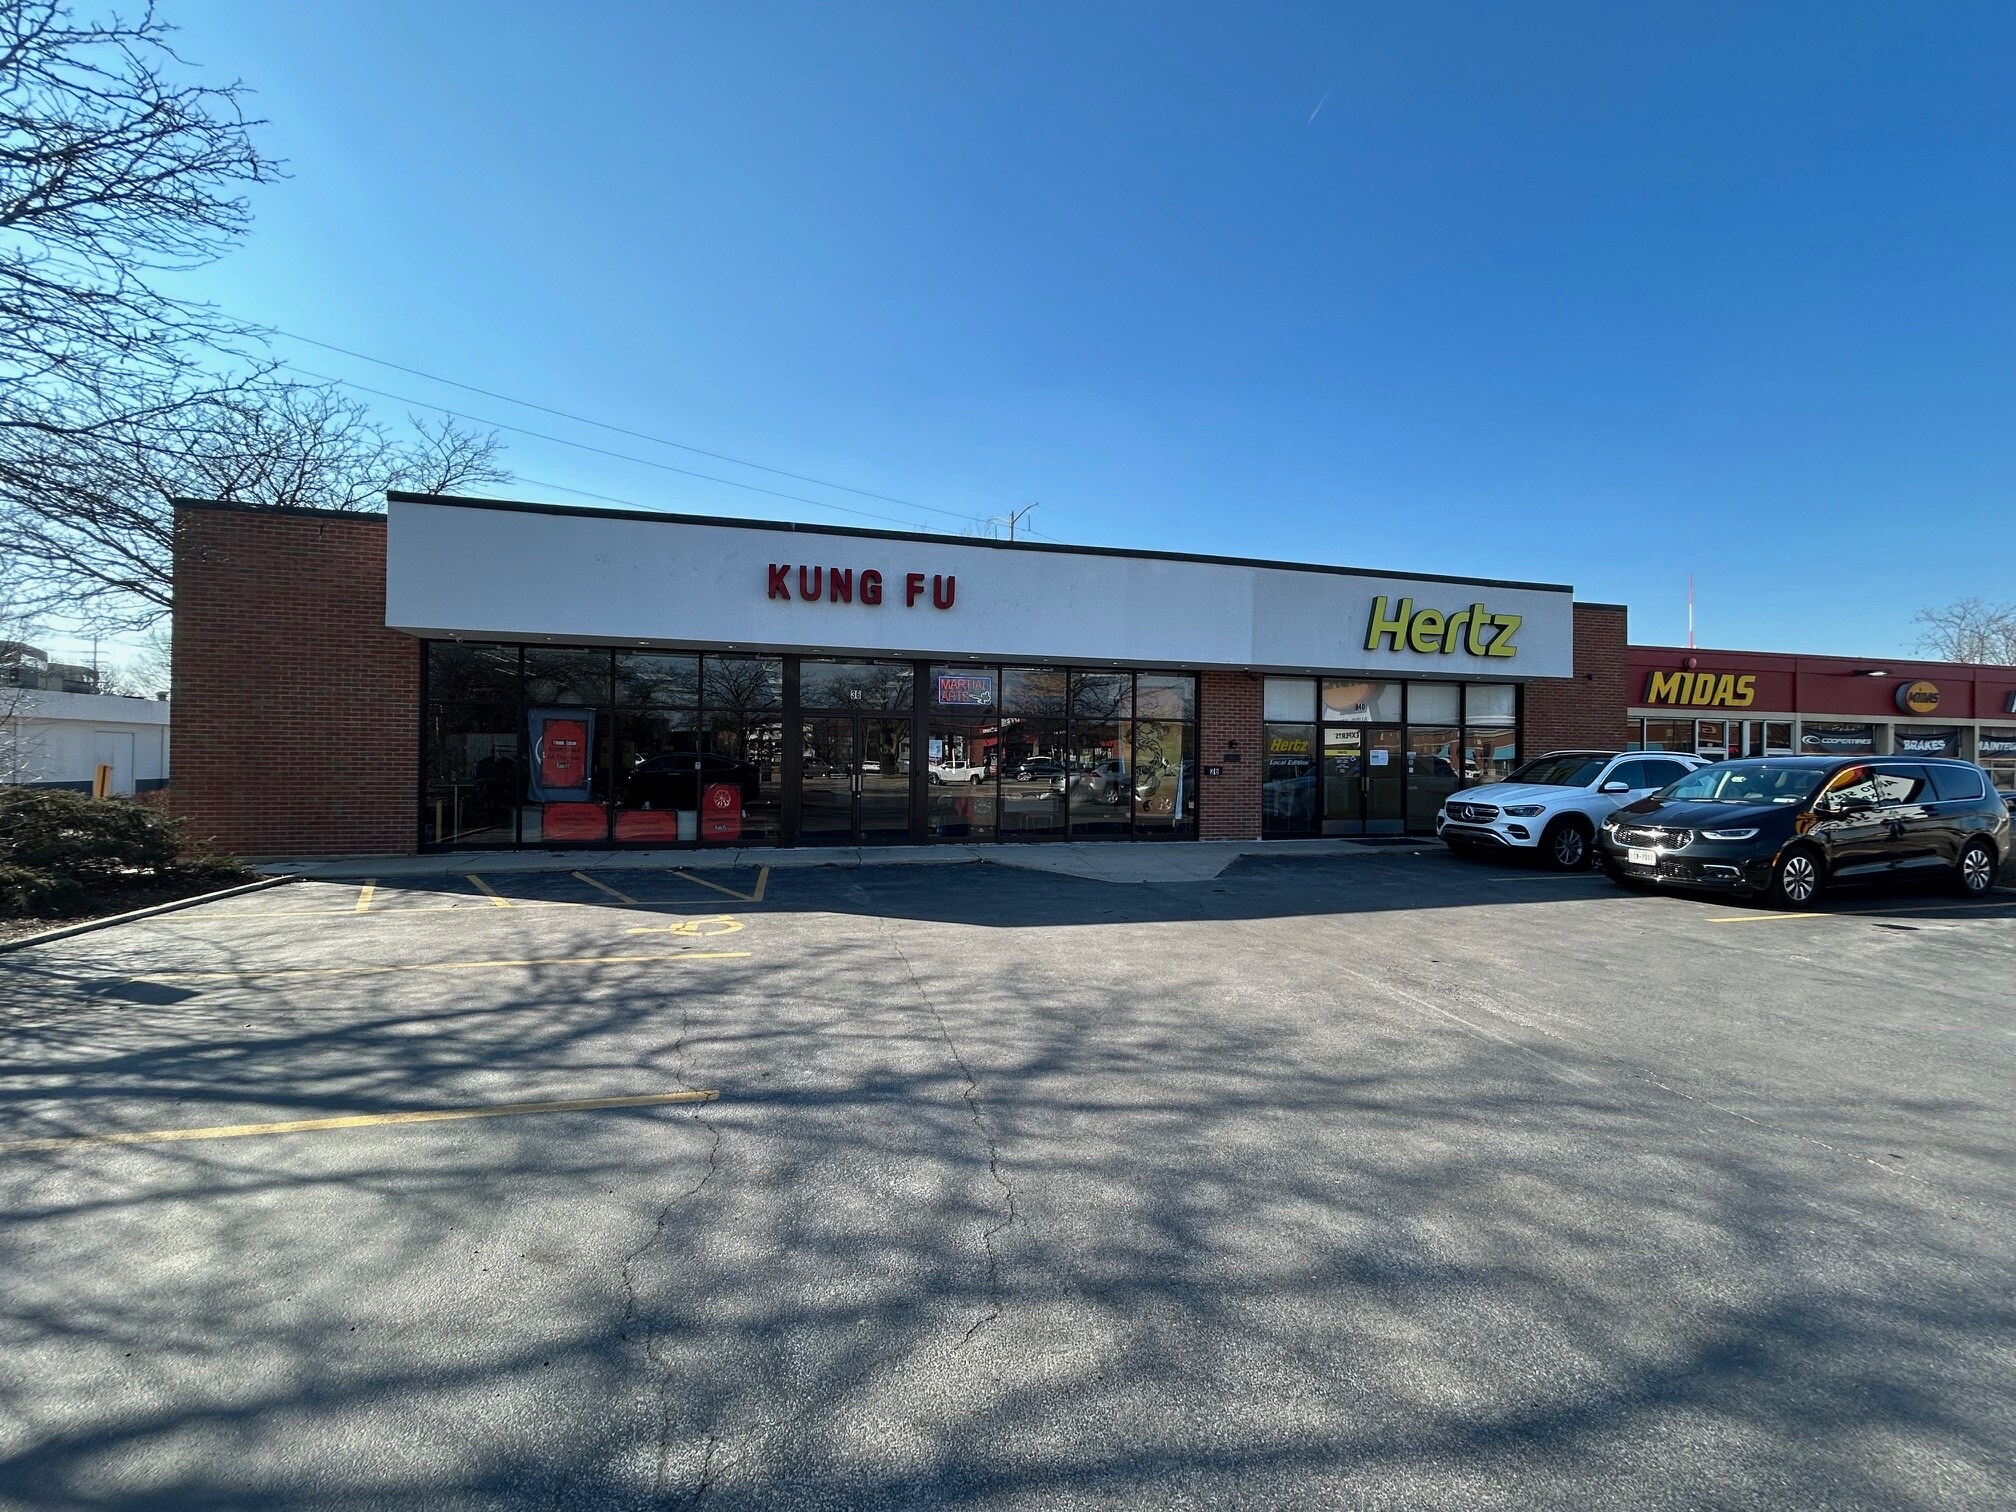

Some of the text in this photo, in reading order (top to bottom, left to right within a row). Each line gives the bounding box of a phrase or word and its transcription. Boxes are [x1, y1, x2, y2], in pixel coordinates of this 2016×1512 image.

[768, 563, 956, 610] KUNG FU
[1363, 595, 1523, 657] Hertz
[941, 678, 989, 691] MARTIAL
[1646, 671, 1756, 707] MIDAS
[941, 691, 969, 702] ARTS
[1909, 691, 1940, 703] MIDAS
[1270, 738, 1309, 752] Hertz
[1903, 739, 1946, 751] BRAKES
